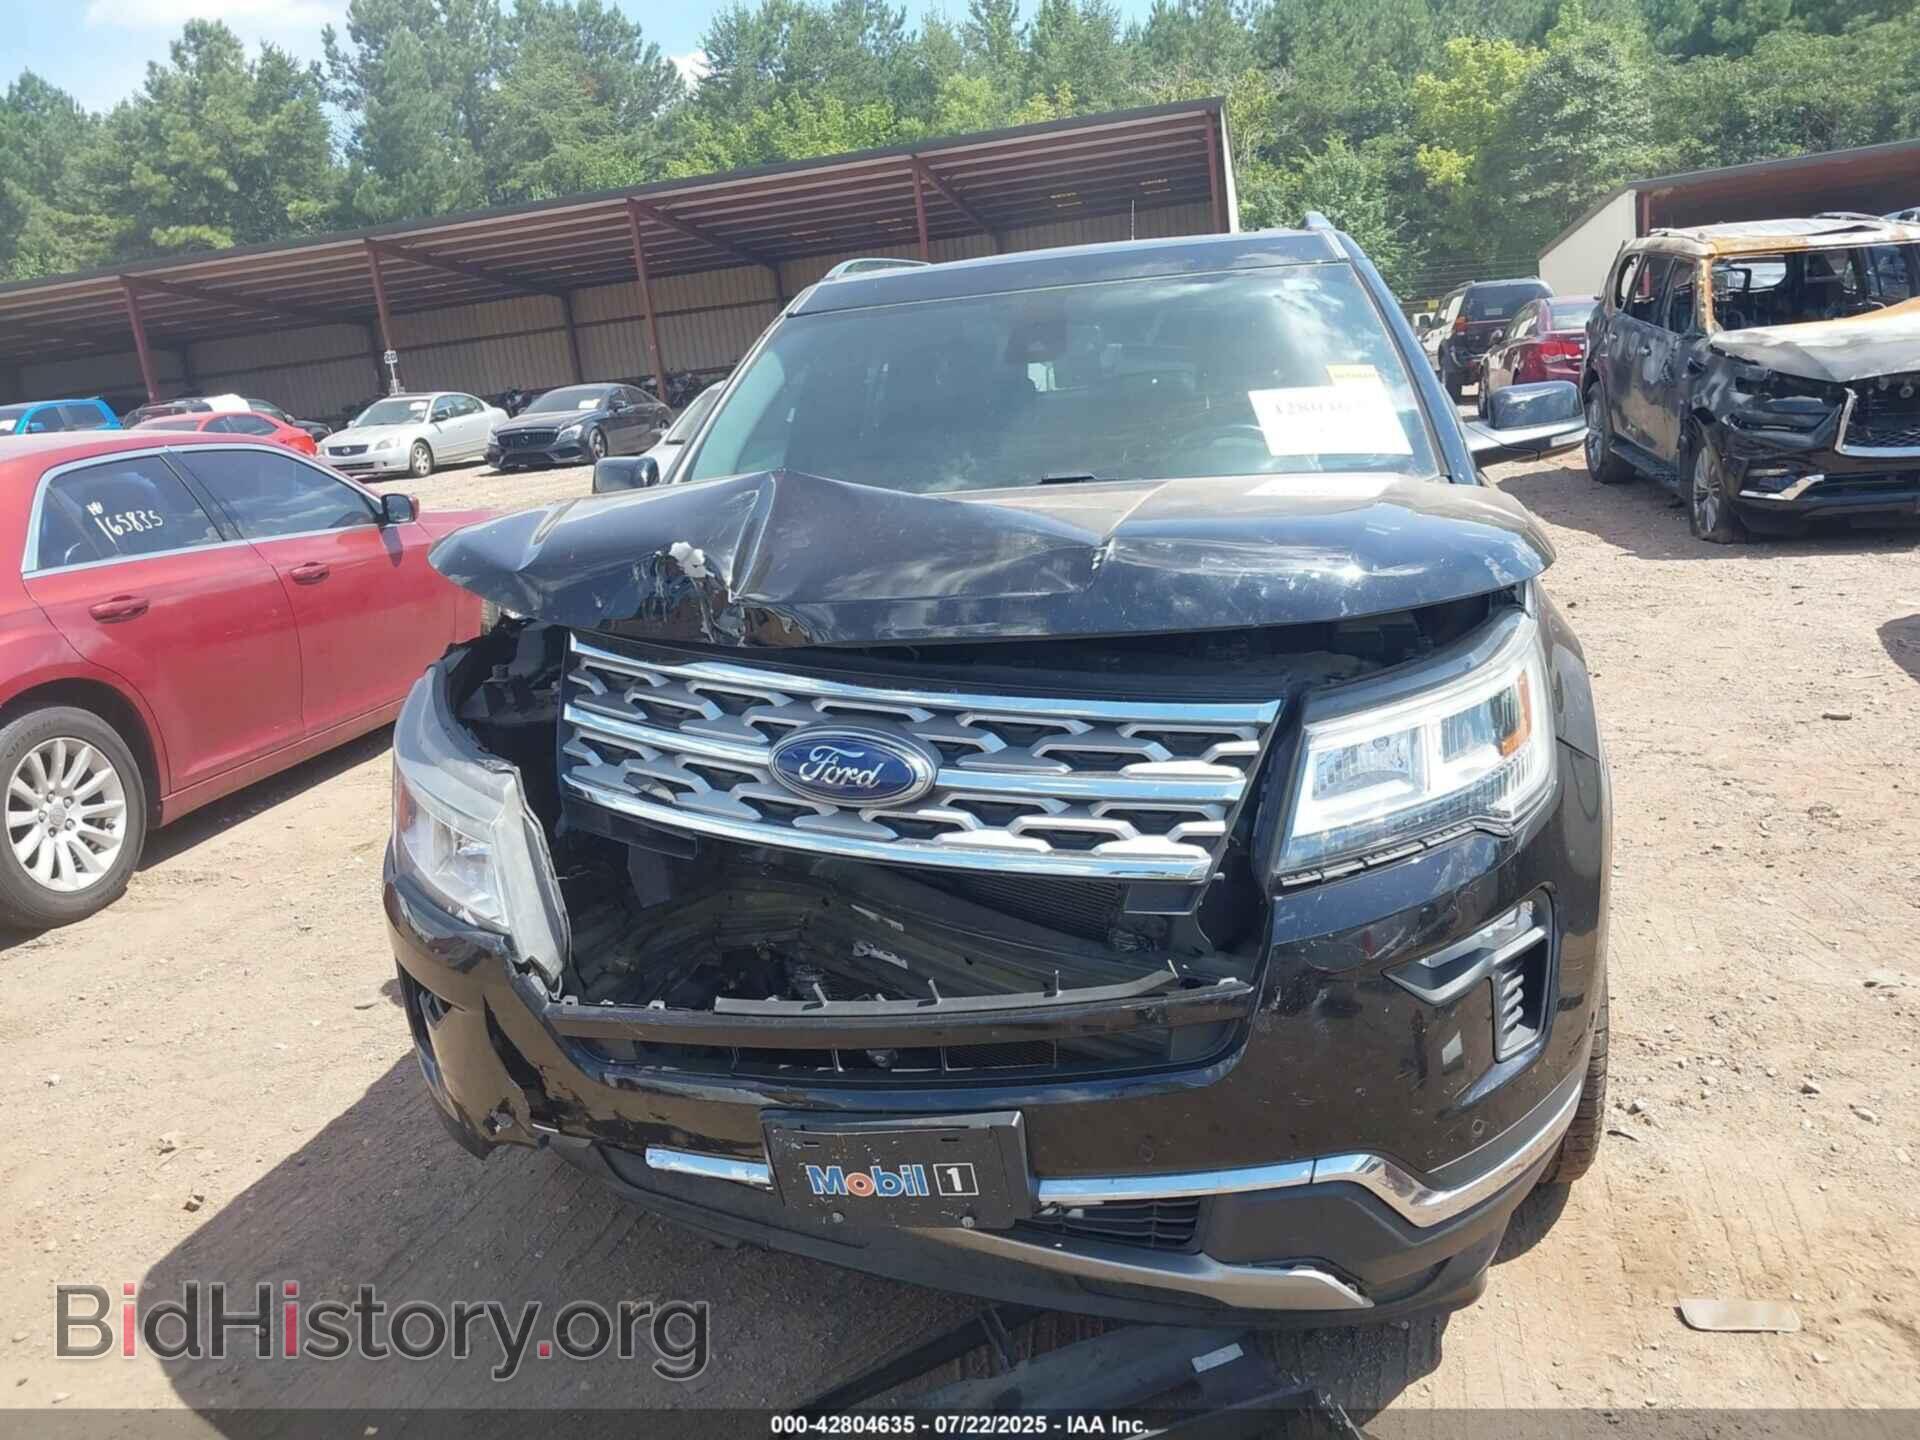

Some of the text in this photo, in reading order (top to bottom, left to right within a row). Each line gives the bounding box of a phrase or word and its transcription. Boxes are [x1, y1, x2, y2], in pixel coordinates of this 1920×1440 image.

[94, 509, 163, 547] 165835
[799, 745, 885, 788] Ford
[805, 1164, 930, 1197] Mobil
